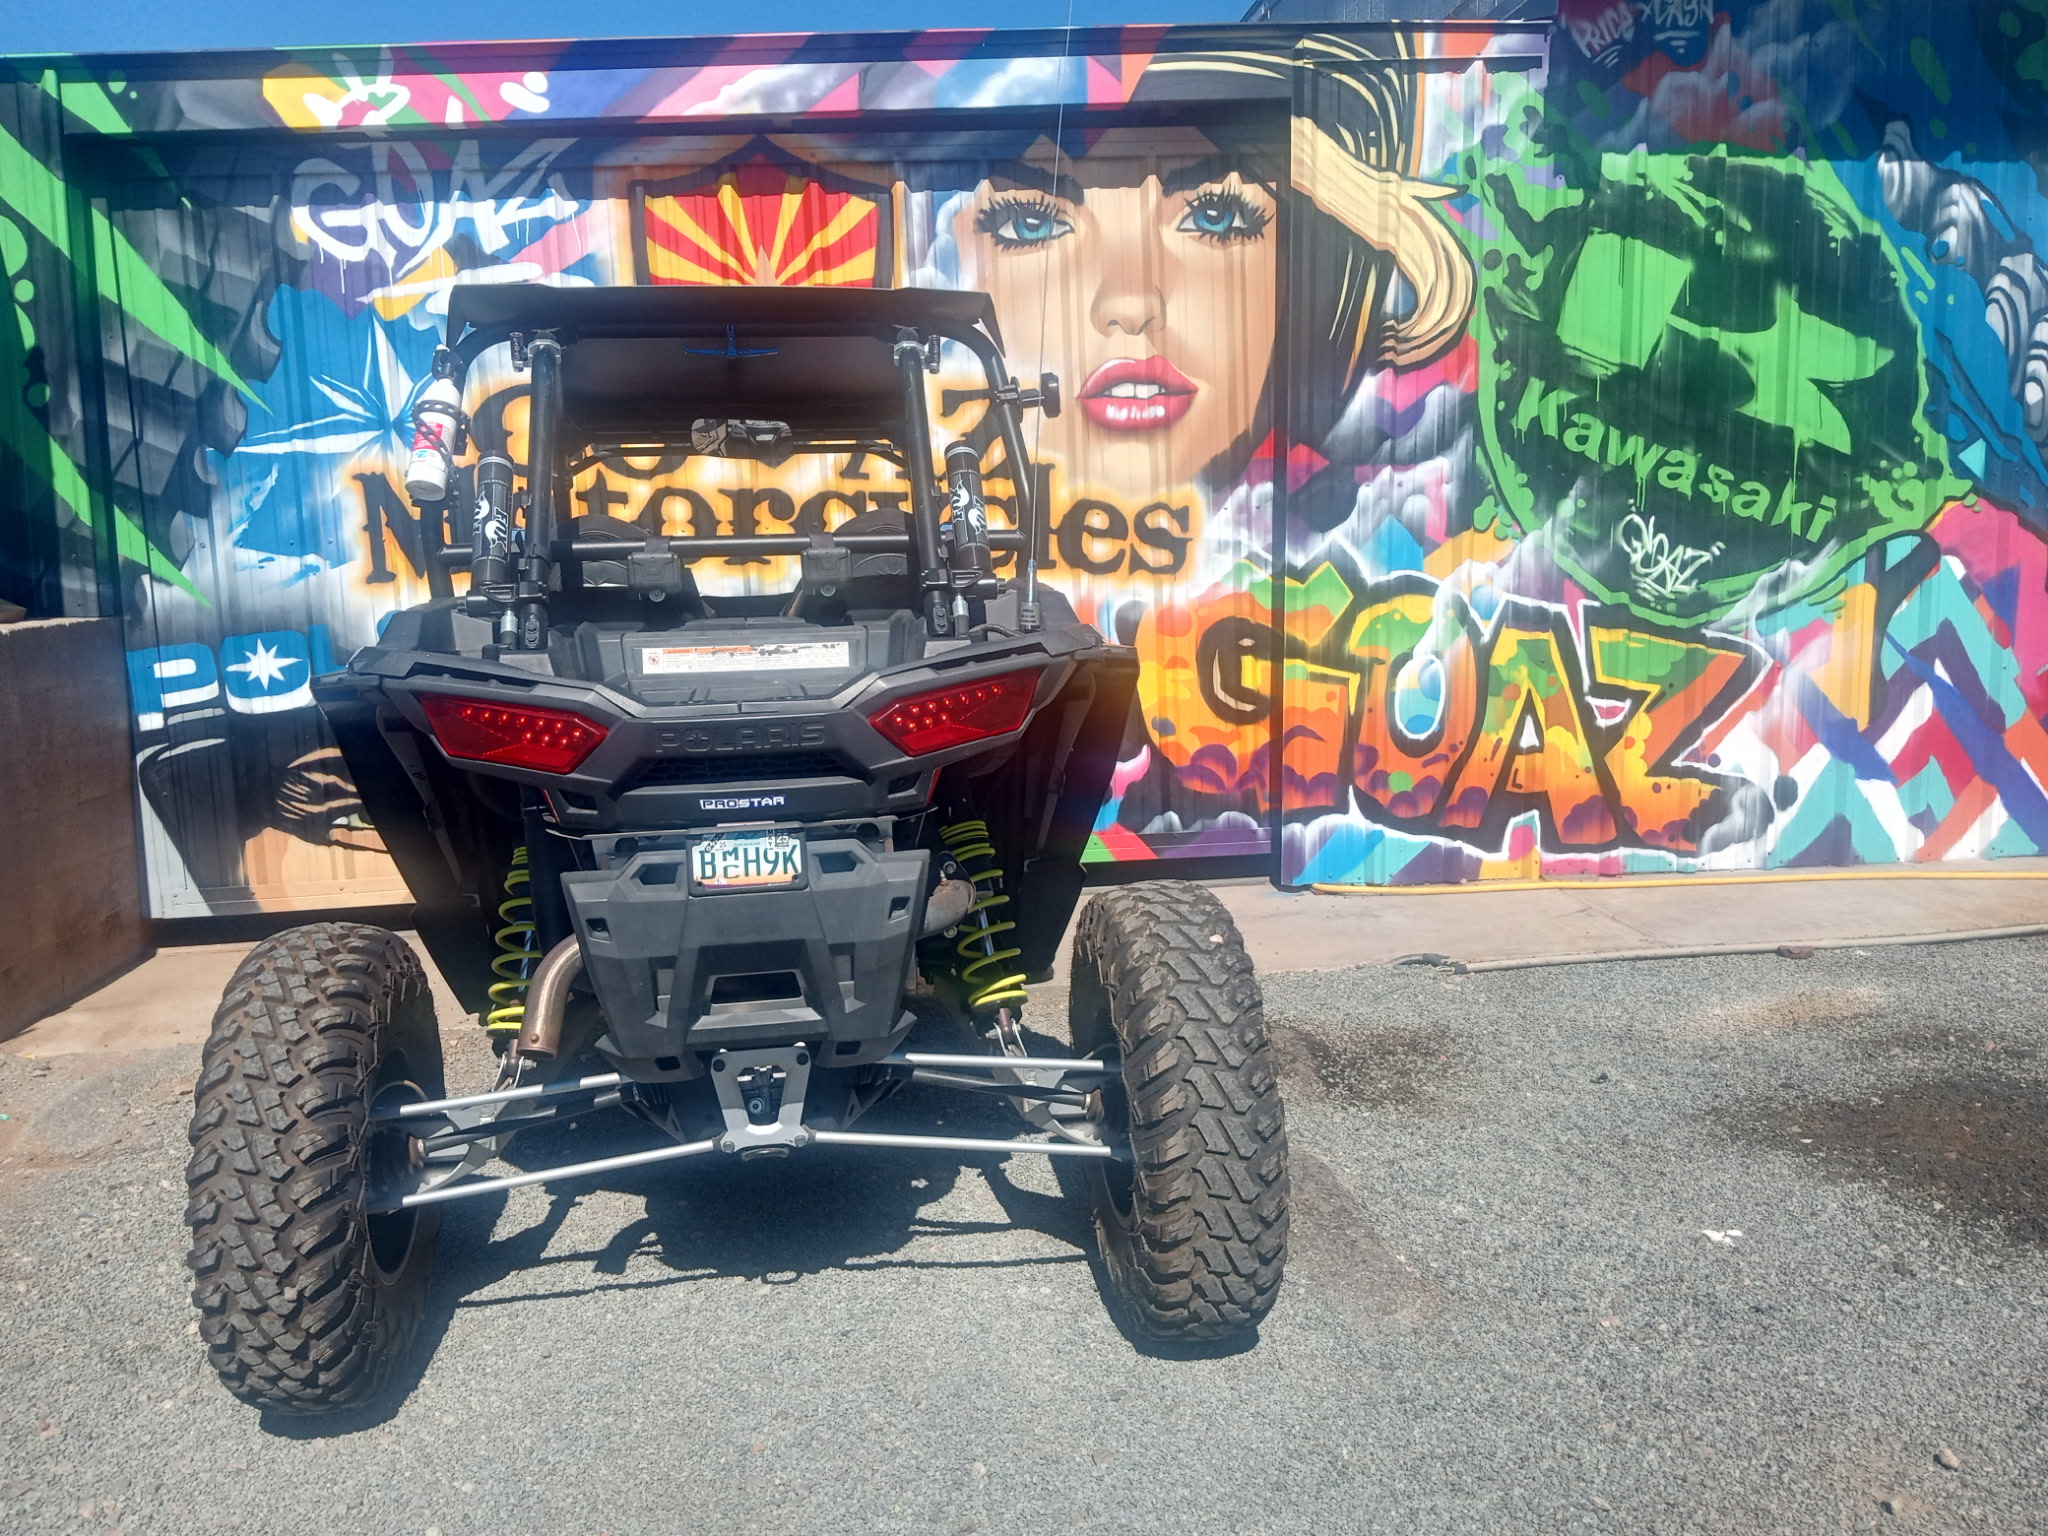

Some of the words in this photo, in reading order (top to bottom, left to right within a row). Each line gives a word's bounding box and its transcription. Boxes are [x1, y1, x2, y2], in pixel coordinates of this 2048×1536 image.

[1512, 378, 1838, 542] Kawasaki
[352, 462, 1193, 584] Mtorccles
[489, 506, 509, 553] FOX
[655, 723, 825, 753] POLARIS
[699, 796, 786, 811] PROSTAR
[776, 833, 789, 844] 25
